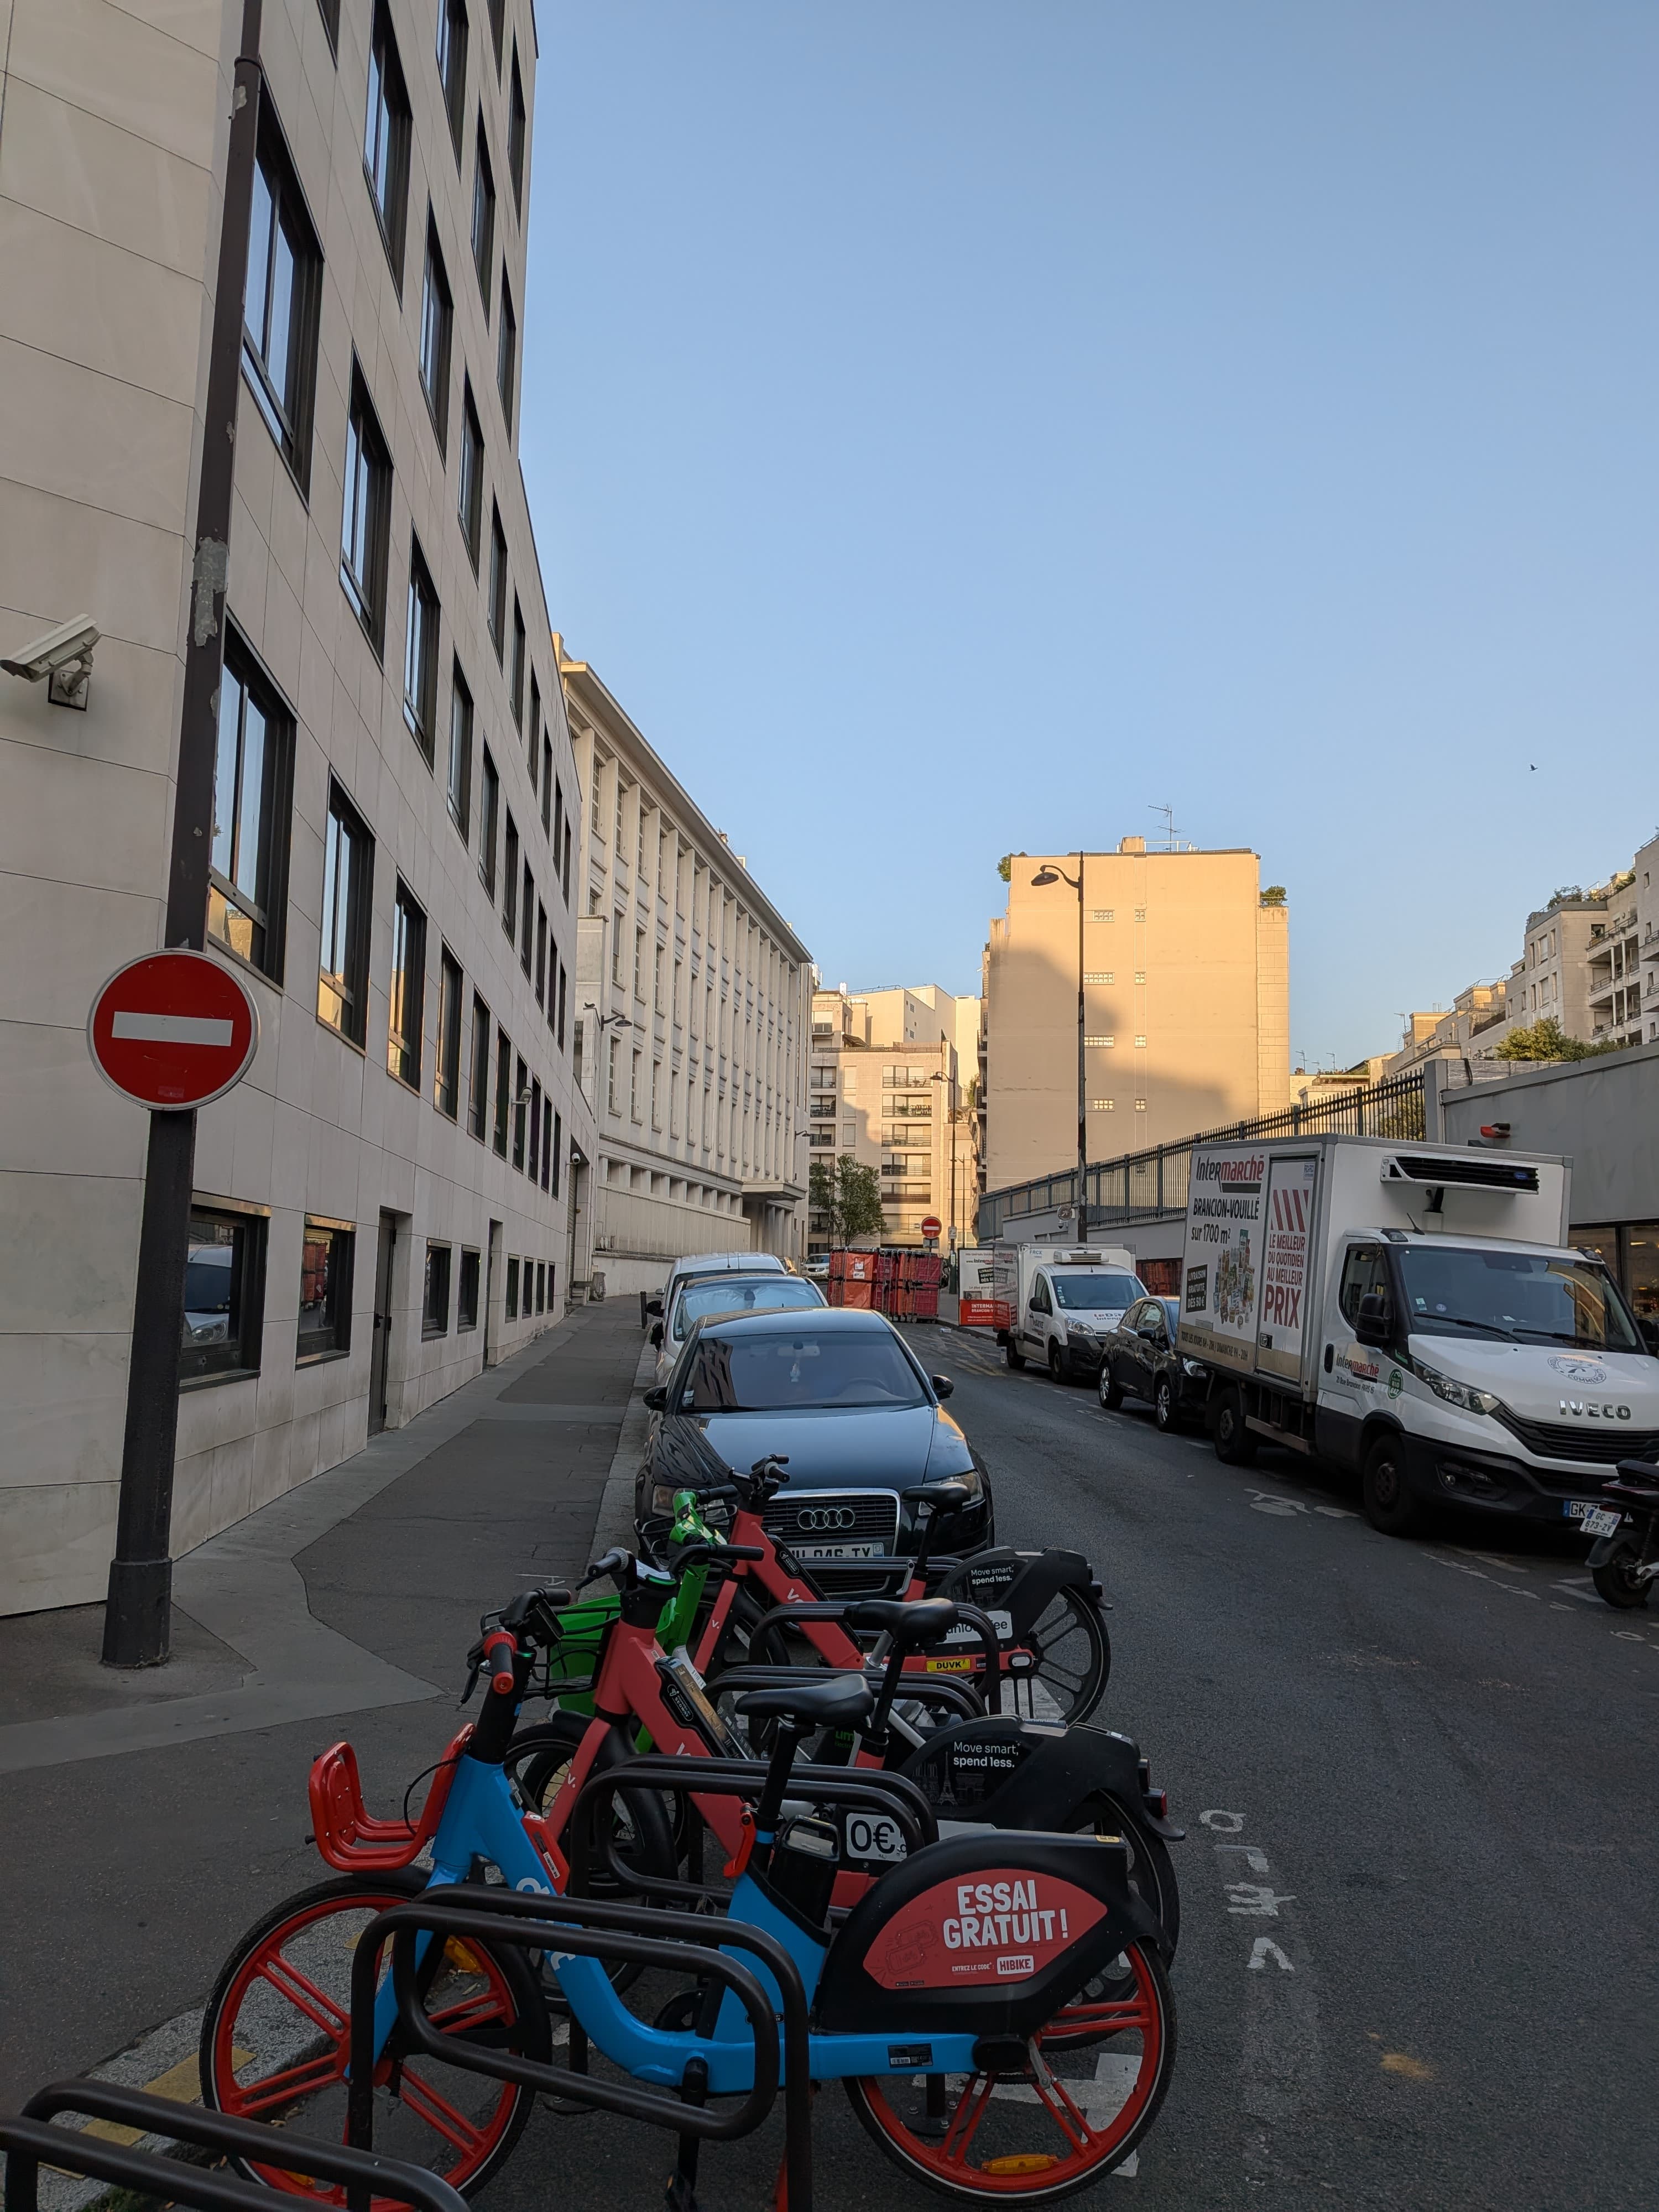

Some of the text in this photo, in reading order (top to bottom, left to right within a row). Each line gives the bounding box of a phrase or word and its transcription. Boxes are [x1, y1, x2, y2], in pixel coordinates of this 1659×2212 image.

[1196, 1155, 1264, 1190] Intermarché
[1193, 1197, 1260, 1220] BRANCION-VOUILLÉ
[1191, 1227, 1202, 1241] sur
[1203, 1223, 1219, 1243] 1700
[1269, 1234, 1305, 1251] LE MEILLEUR
[1268, 1251, 1304, 1268] DU QUOTIDIEN
[1266, 1267, 1302, 1286] AU MEILLEUR
[1264, 1284, 1302, 1329] PRIX
[1336, 1354, 1379, 1377] Intermarché
[1346, 1379, 1361, 1390] Brancion
[1559, 1400, 1631, 1420] IVECO
[992, 1566, 1014, 1574] smart,
[972, 1575, 995, 1585] spend
[954, 1741, 1019, 1756] Move smart,
[953, 1756, 1015, 1768] spend less.
[957, 1880, 1037, 1916] ESSAI
[999, 1959, 1031, 1971] HIBIKE
